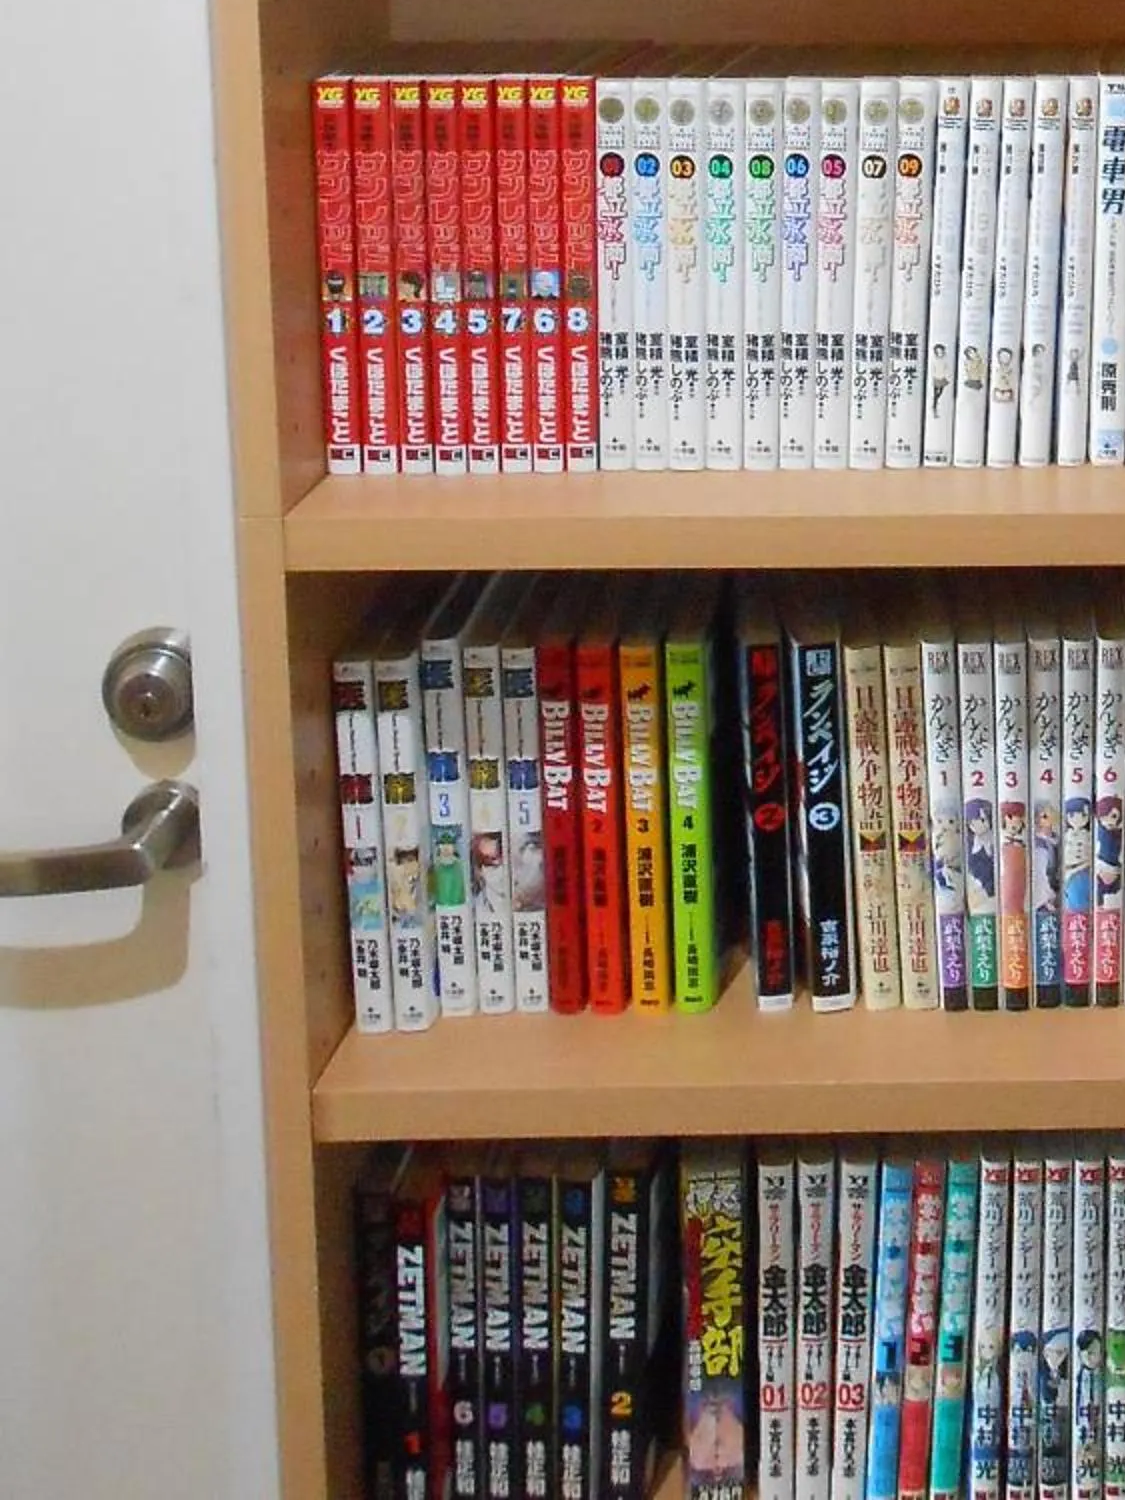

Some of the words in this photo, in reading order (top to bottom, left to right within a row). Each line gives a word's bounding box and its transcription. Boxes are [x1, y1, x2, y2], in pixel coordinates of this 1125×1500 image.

[638, 158, 656, 172] 02
[672, 160, 692, 175] 03
[711, 160, 730, 174] 04
[787, 159, 806, 172] 06
[823, 160, 843, 174] 05
[864, 160, 884, 175] 07
[900, 159, 919, 174] 09
[328, 309, 341, 333] 1
[363, 309, 384, 334] 2
[402, 309, 422, 333] 3
[434, 309, 456, 334] 4
[467, 309, 488, 333] 5
[502, 308, 522, 332] 7
[534, 308, 555, 332] 6
[567, 308, 589, 332] 8
[972, 771, 985, 787] 2
[1005, 771, 1019, 788] 3
[1040, 769, 1054, 785] 4
[1071, 767, 1083, 783] 5
[1103, 767, 1117, 783] 6
[439, 793, 450, 818] 3
[519, 800, 530, 826] 5
[814, 806, 833, 827] 3
[637, 818, 650, 834] 3
[681, 816, 694, 831] 4
[449, 1221, 475, 1349] ZETMAN
[485, 1223, 510, 1351] ZETMAN
[523, 1222, 549, 1349] ZETMAN
[609, 1212, 637, 1340] ZETMAN
[561, 1225, 586, 1353] ZETMAN
[762, 1264, 789, 1337] 金太郎
[802, 1264, 827, 1337] 金太郎
[842, 1264, 867, 1337] 金太郎
[397, 1245, 427, 1376] ZETMAN
[611, 1392, 633, 1416] 2
[762, 1385, 786, 1407] 01
[801, 1384, 827, 1406] 02
[838, 1385, 864, 1406] 03
[454, 1401, 473, 1424] 6
